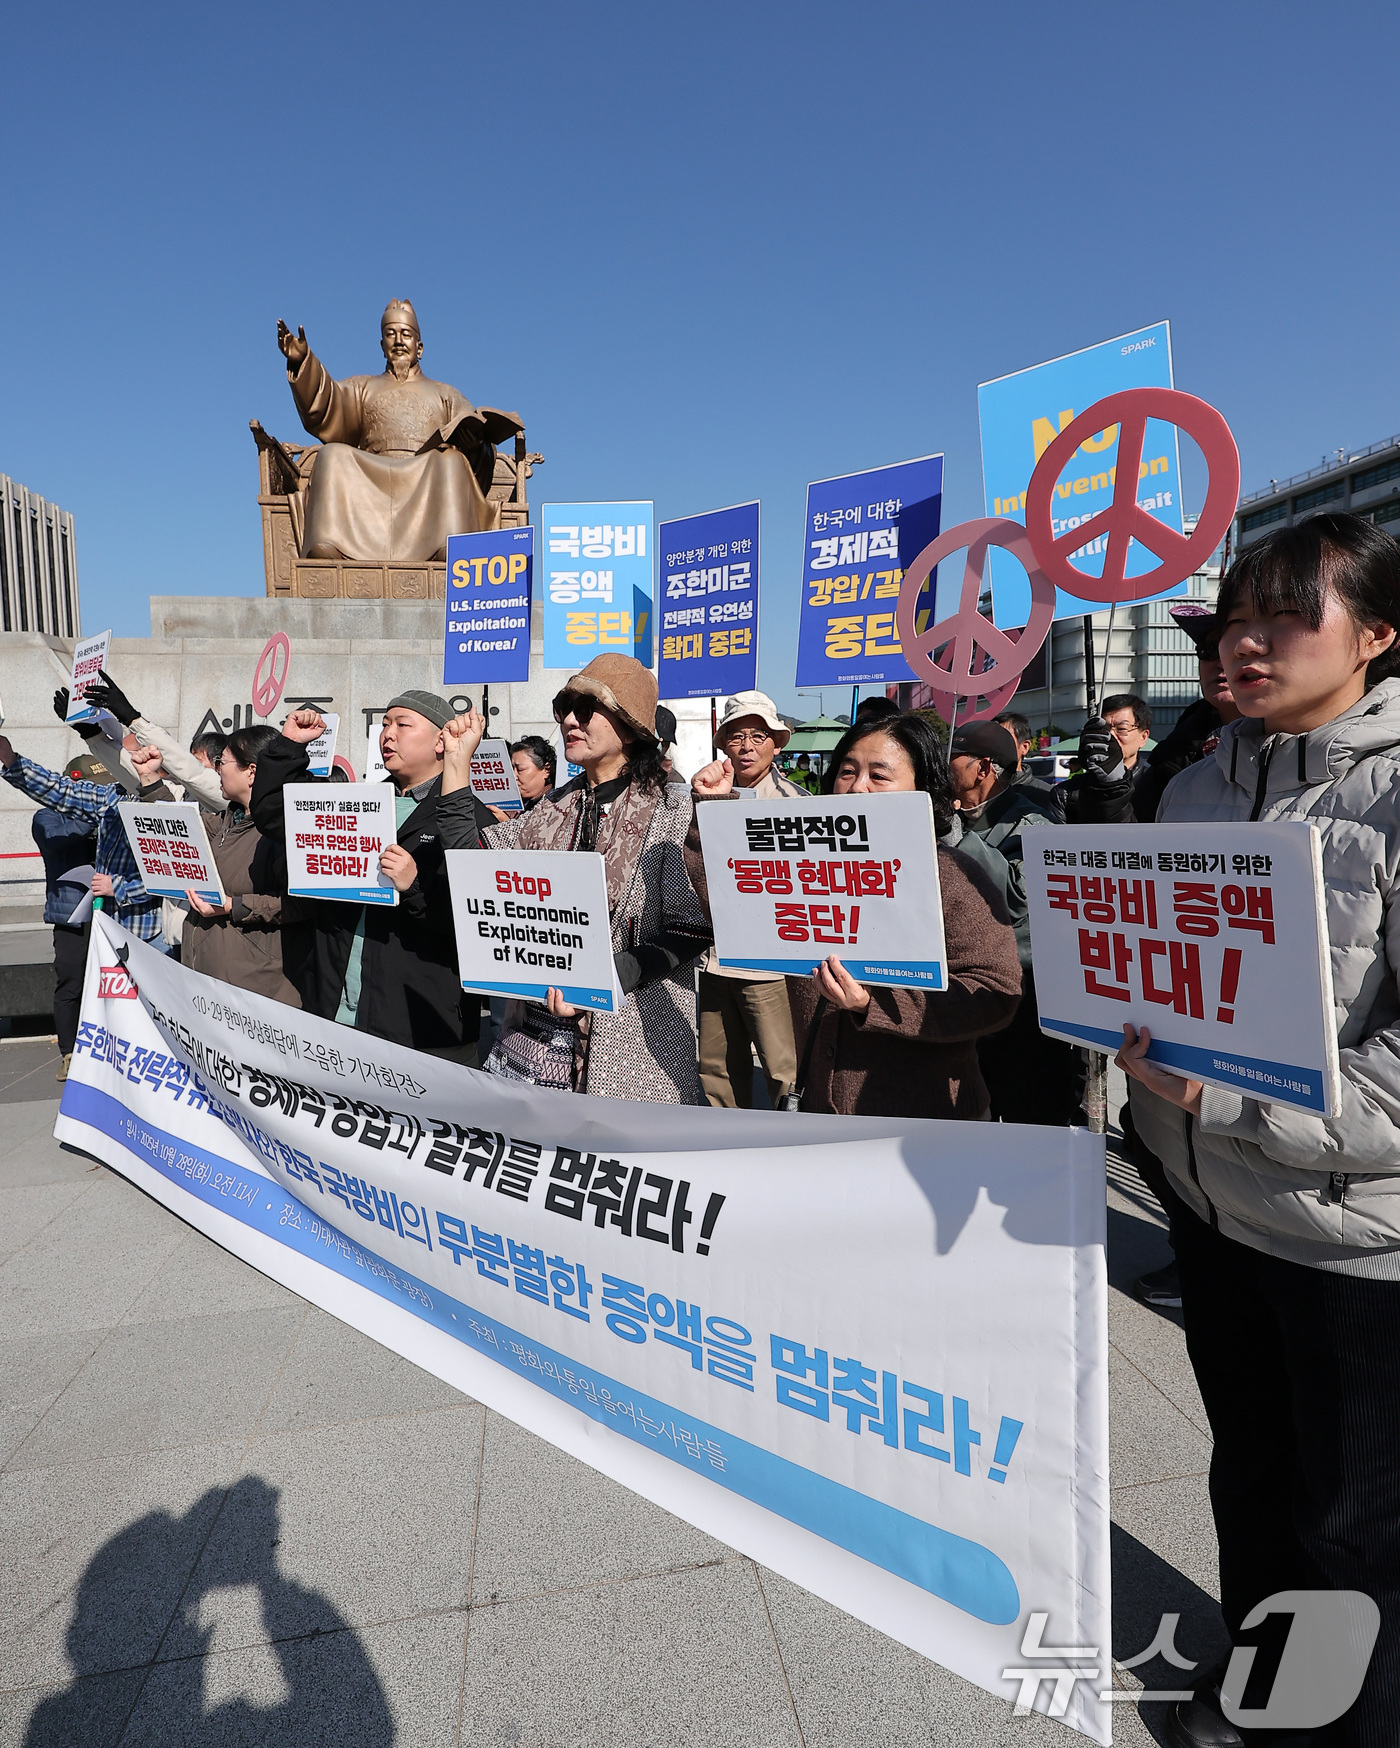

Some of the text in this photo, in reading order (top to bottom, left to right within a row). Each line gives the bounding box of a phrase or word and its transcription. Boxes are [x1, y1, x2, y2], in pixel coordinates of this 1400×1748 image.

[1120, 337, 1156, 356] SPARK
[812, 498, 903, 533] 한국에 대한
[513, 532, 529, 541] SPARK
[548, 524, 646, 559] 국방비
[809, 526, 900, 571] 경제적
[666, 538, 752, 567] 양안분쟁 개입 위한
[451, 553, 528, 589] STOP
[665, 561, 751, 600] 주한미군
[549, 570, 614, 604] 증액
[450, 595, 529, 613] U.S. Economic
[663, 600, 753, 630] 전략적 유연성
[448, 615, 526, 634] Exploitation
[565, 611, 649, 646] 중단!
[459, 637, 518, 653] of Korea!
[662, 627, 752, 661] 확대 중단
[470, 761, 505, 775] 유연성
[472, 778, 510, 791] 멈춰라!
[338, 801, 361, 812] 실효성
[362, 801, 381, 813] 없다!
[133, 816, 189, 838] 한국에 대한
[315, 815, 357, 831] 주한미군
[745, 814, 870, 852] 불법적인
[136, 837, 200, 860] 경제적 강압과
[295, 833, 382, 853] 전략적 유연성 행사
[142, 858, 208, 881] 갈취를 멈춰라!
[306, 854, 368, 877] 중단하라!
[1043, 849, 1273, 877] 한국을 대중 대결에 동원하기 위한
[495, 870, 552, 901] Stop
[466, 898, 589, 926] U.S. Economic
[775, 902, 860, 944] 중단!
[1046, 873, 1276, 945] 국방비 증액
[478, 921, 583, 949] Exploitation
[493, 945, 573, 971] of Korea!
[864, 966, 934, 980] 평화와통일을여는사람들
[1077, 927, 1243, 1025] 반대!
[590, 995, 608, 1005] SPARK
[223, 1006, 300, 1060] 한미정상회담에
[302, 1040, 346, 1077] 즈음한
[1212, 1057, 1312, 1096] 평화와통일을여는사람들
[206, 1047, 243, 1097] 대한
[241, 1062, 327, 1128] 경제적
[324, 1091, 426, 1160] 강압과
[424, 1117, 543, 1202] 갈취를
[544, 1146, 727, 1256] 멈춰라!
[160, 1144, 177, 1167] 10월
[176, 1153, 213, 1185] 28일(화)
[209, 1172, 236, 1196] 오전
[232, 1182, 260, 1208] 11시
[279, 1203, 302, 1230] 장소
[310, 1220, 351, 1260] 미대사관
[75, 1021, 131, 1075] 주한미군
[128, 1045, 191, 1100] 전략적
[273, 1138, 324, 1194] 한국
[319, 1162, 433, 1251] 국방비의
[436, 1210, 593, 1323] 무분별한
[600, 1272, 757, 1392] 증액을
[770, 1333, 1024, 1484] 멈춰라!
[468, 1318, 499, 1350] 주최
[510, 1342, 728, 1473] 평화와통일을여는사람들
